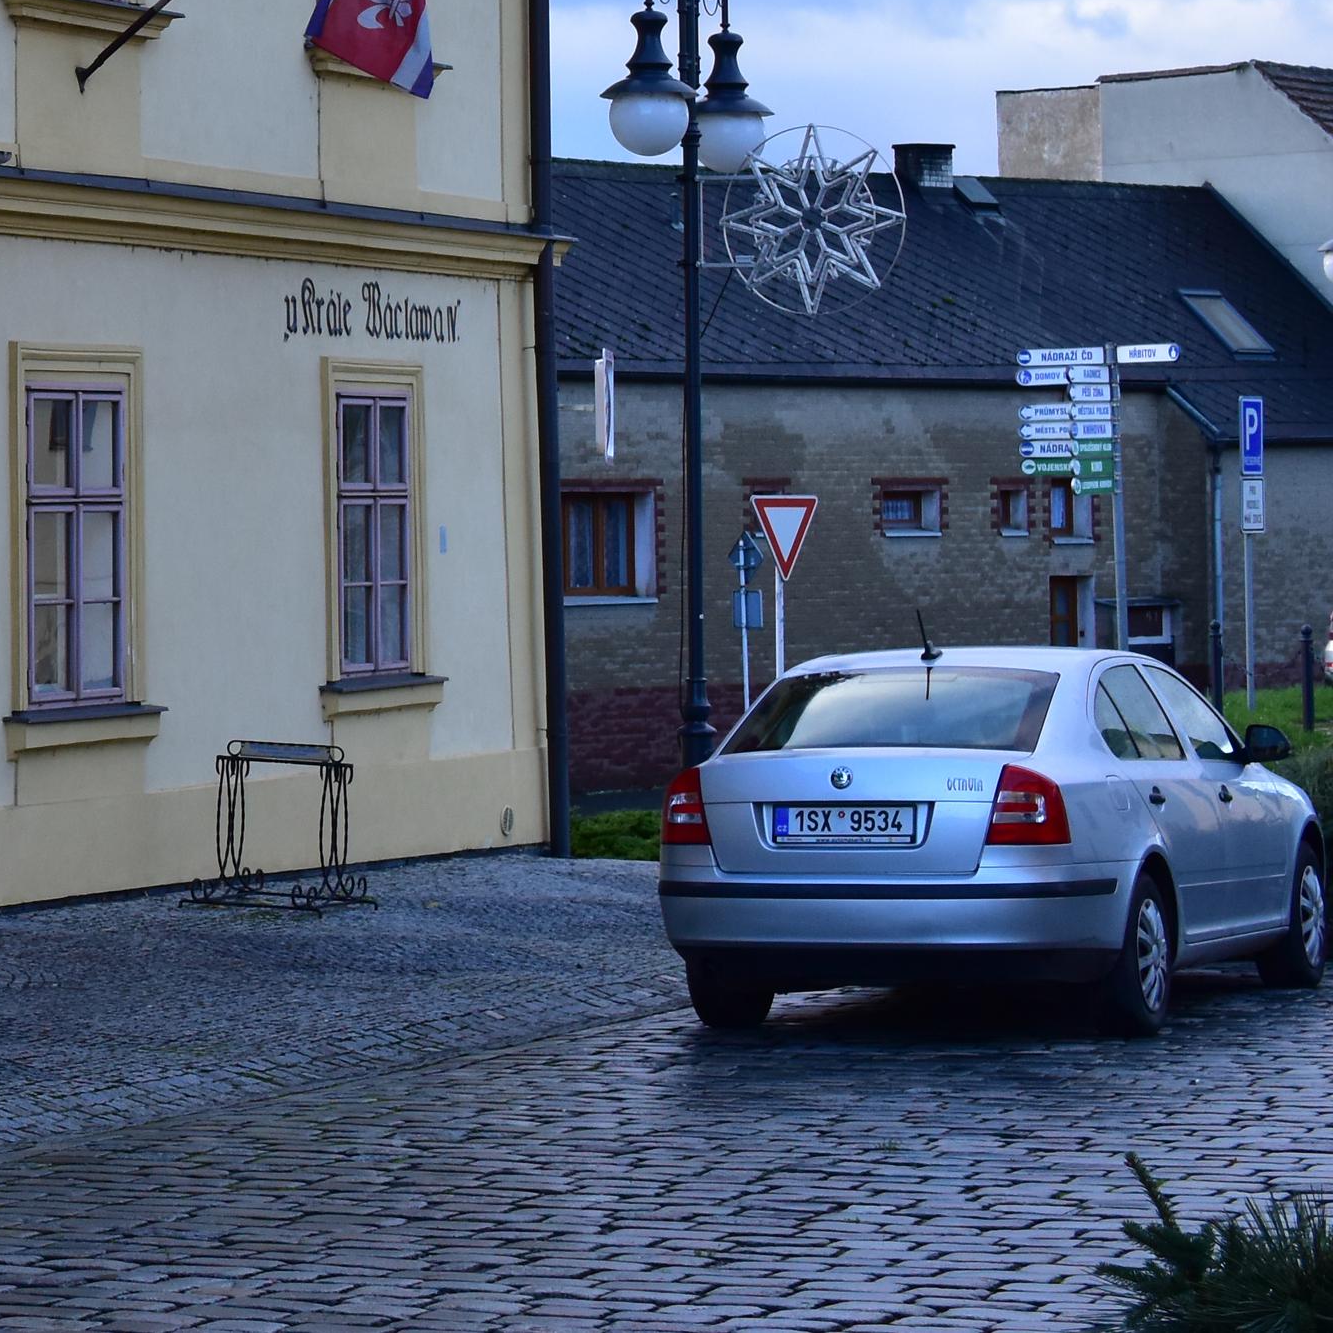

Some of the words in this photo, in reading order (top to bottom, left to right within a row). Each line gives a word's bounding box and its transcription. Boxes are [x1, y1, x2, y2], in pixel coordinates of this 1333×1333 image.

[1041, 349, 1078, 362] NÁDRAŽÍ
[1081, 348, 1093, 361] ČD
[1128, 347, 1157, 359] HŘBITOV
[1034, 371, 1061, 381] DOMOV
[1245, 407, 1258, 450] P
[946, 777, 984, 792] OCTAVIA
[795, 810, 832, 832] 1SX
[850, 810, 903, 832] 9534
